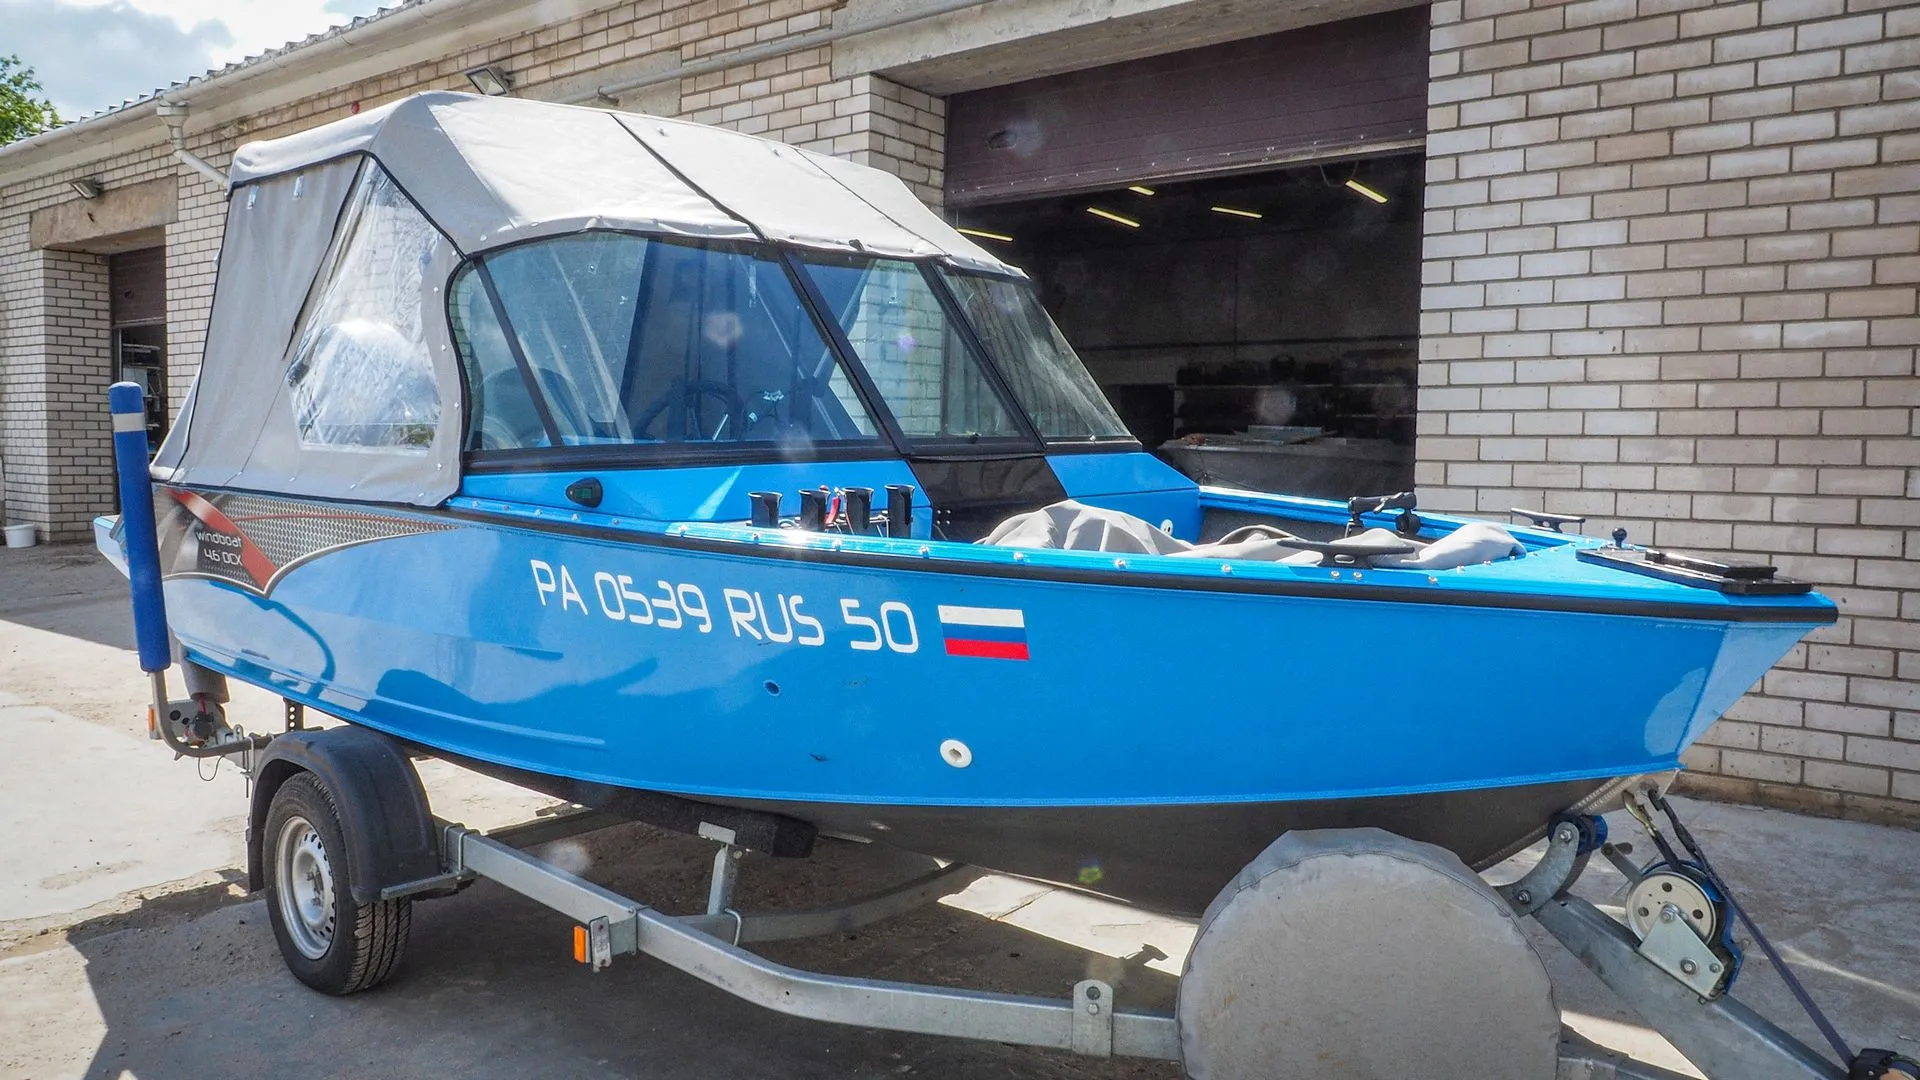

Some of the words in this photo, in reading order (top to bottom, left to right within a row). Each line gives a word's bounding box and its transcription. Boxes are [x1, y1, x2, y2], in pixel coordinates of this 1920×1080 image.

[203, 548, 221, 562] 46
[530, 560, 588, 616] PA
[594, 571, 712, 633] 0539
[723, 588, 825, 646] RUS
[840, 598, 919, 654] 50
